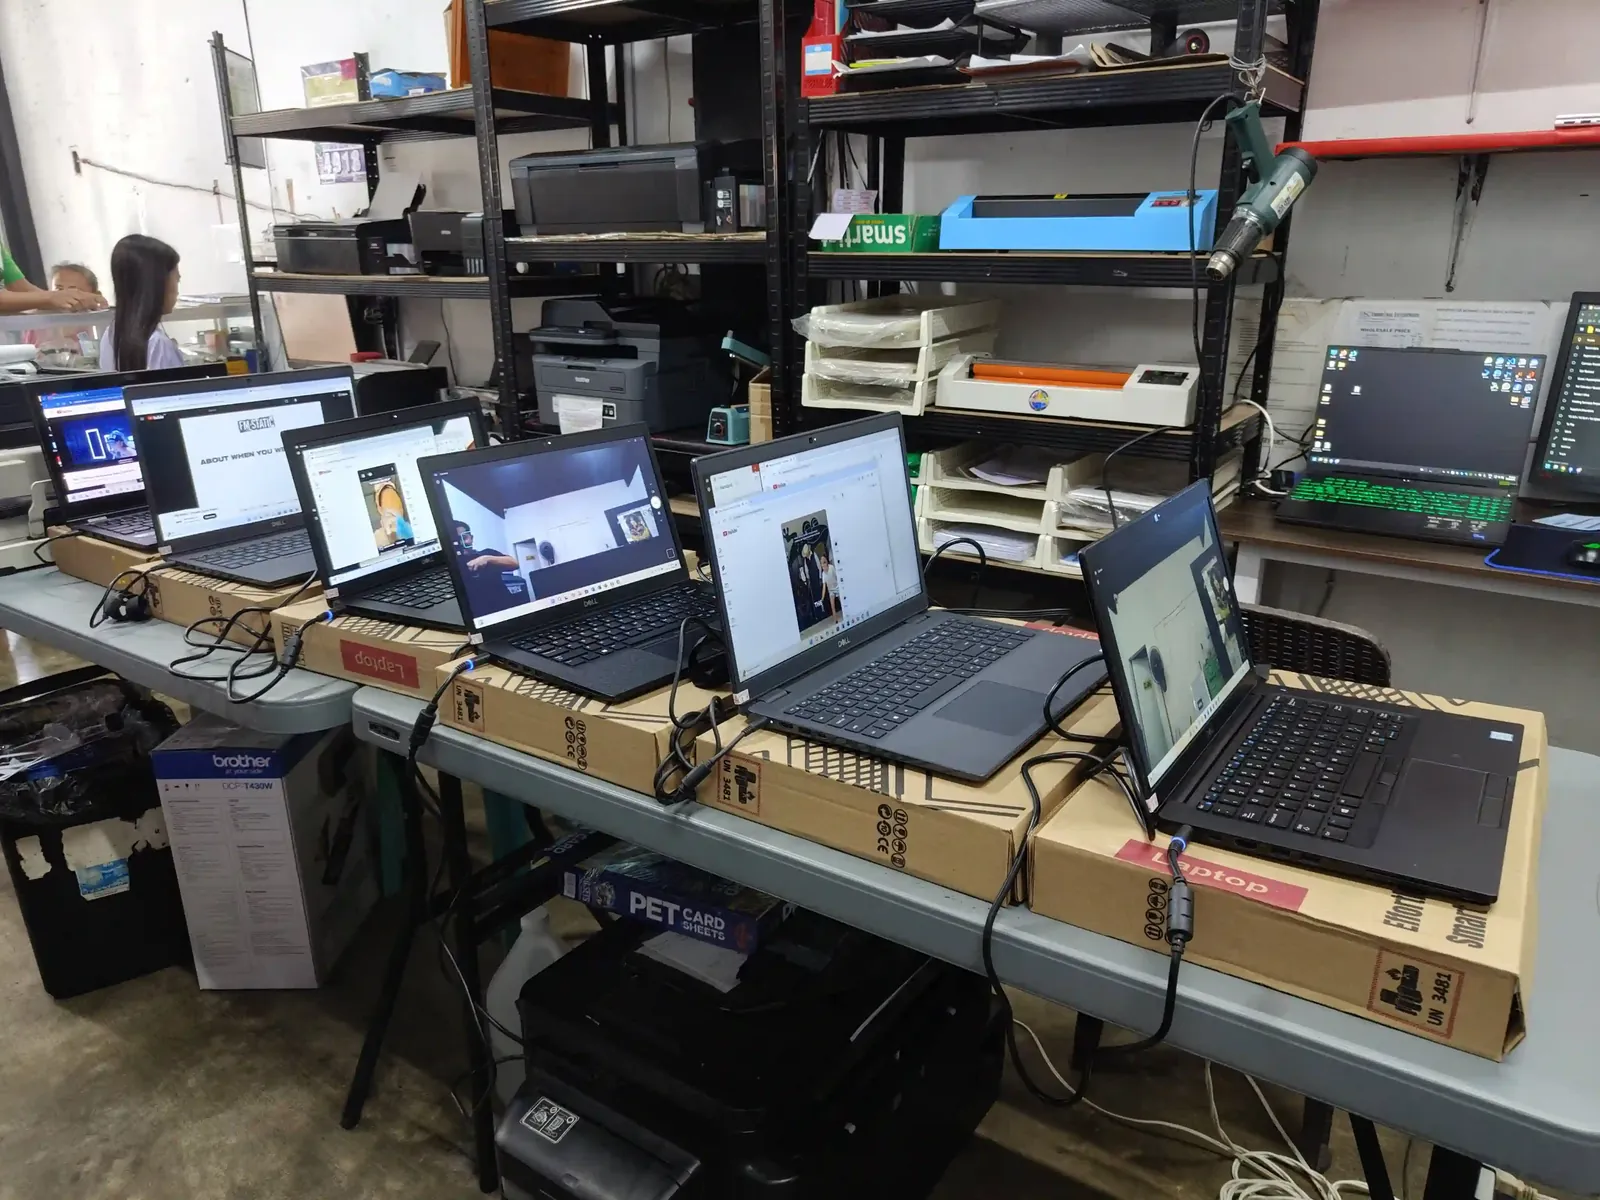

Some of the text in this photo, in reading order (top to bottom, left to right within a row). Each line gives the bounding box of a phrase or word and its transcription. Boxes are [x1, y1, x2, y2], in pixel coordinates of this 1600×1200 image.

[200, 455, 229, 466] ABOUT
[230, 451, 255, 461] WHEN
[256, 448, 273, 456] YOU
[354, 651, 404, 679] Laptop
[456, 685, 464, 721] UN 3481
[212, 754, 271, 768] brother
[723, 759, 732, 801] UN 3481
[1151, 850, 1269, 894] Laptop
[630, 891, 726, 930] PET CARD
[682, 921, 726, 941] SHEETS
[1427, 971, 1452, 1026] UN 3481
